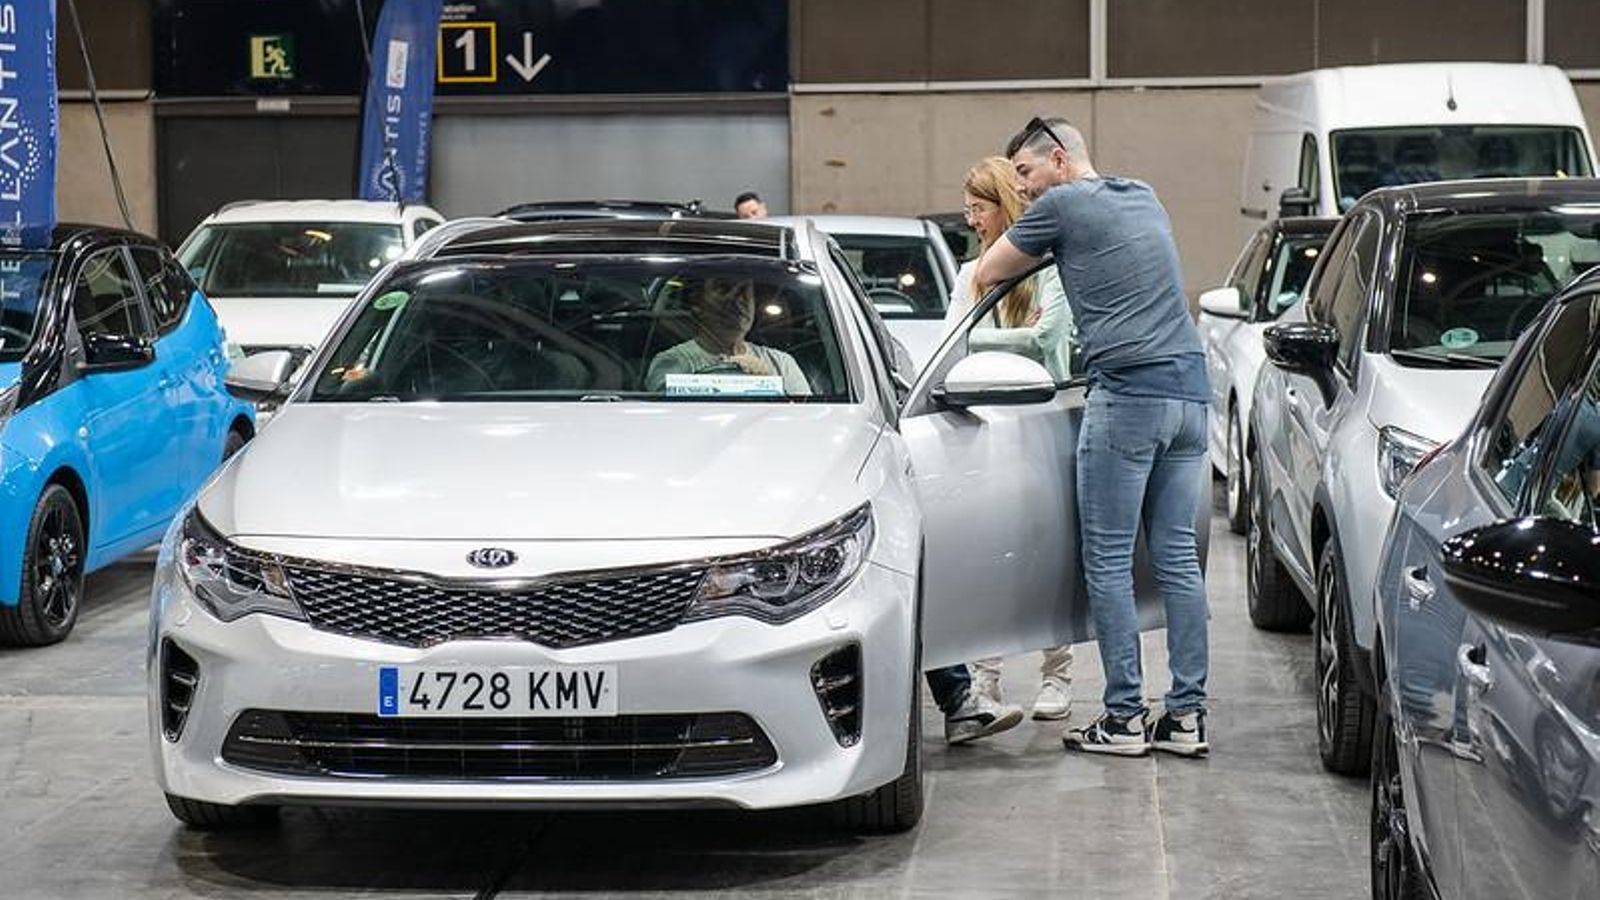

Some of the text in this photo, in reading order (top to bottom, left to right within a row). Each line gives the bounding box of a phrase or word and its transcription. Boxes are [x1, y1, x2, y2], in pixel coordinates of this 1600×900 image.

[455, 29, 475, 71] 1
[469, 548, 513, 567] KIA
[409, 671, 605, 711] 4728 KMV
